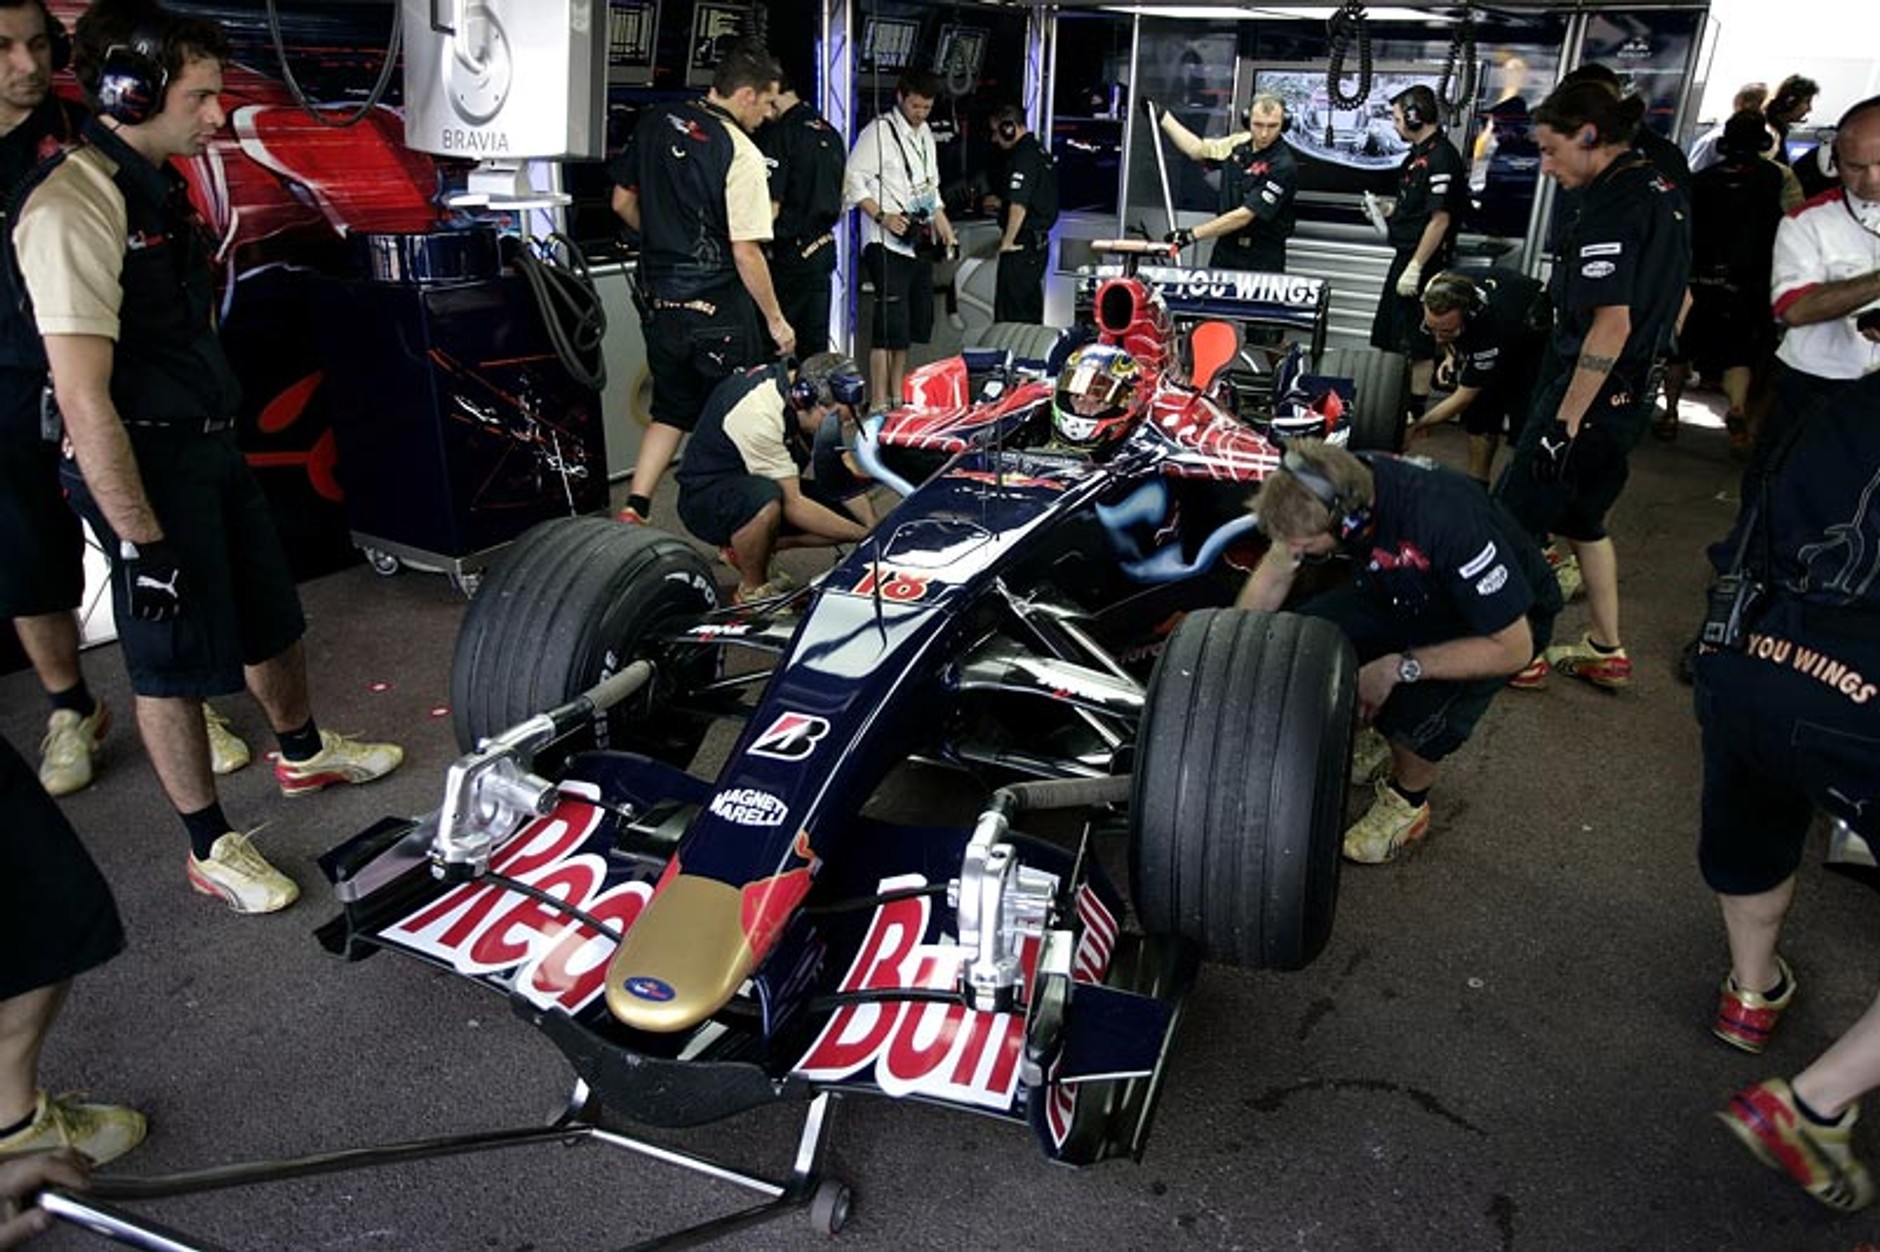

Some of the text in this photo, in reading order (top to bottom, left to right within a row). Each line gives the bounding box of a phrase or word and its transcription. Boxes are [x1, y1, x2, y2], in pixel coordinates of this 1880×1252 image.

[442, 129, 510, 151] BRAVIA
[1177, 270, 1227, 297] YOU
[1233, 273, 1324, 304] WINGS
[850, 561, 928, 602] 18
[1748, 634, 1878, 704] YOU WINGS
